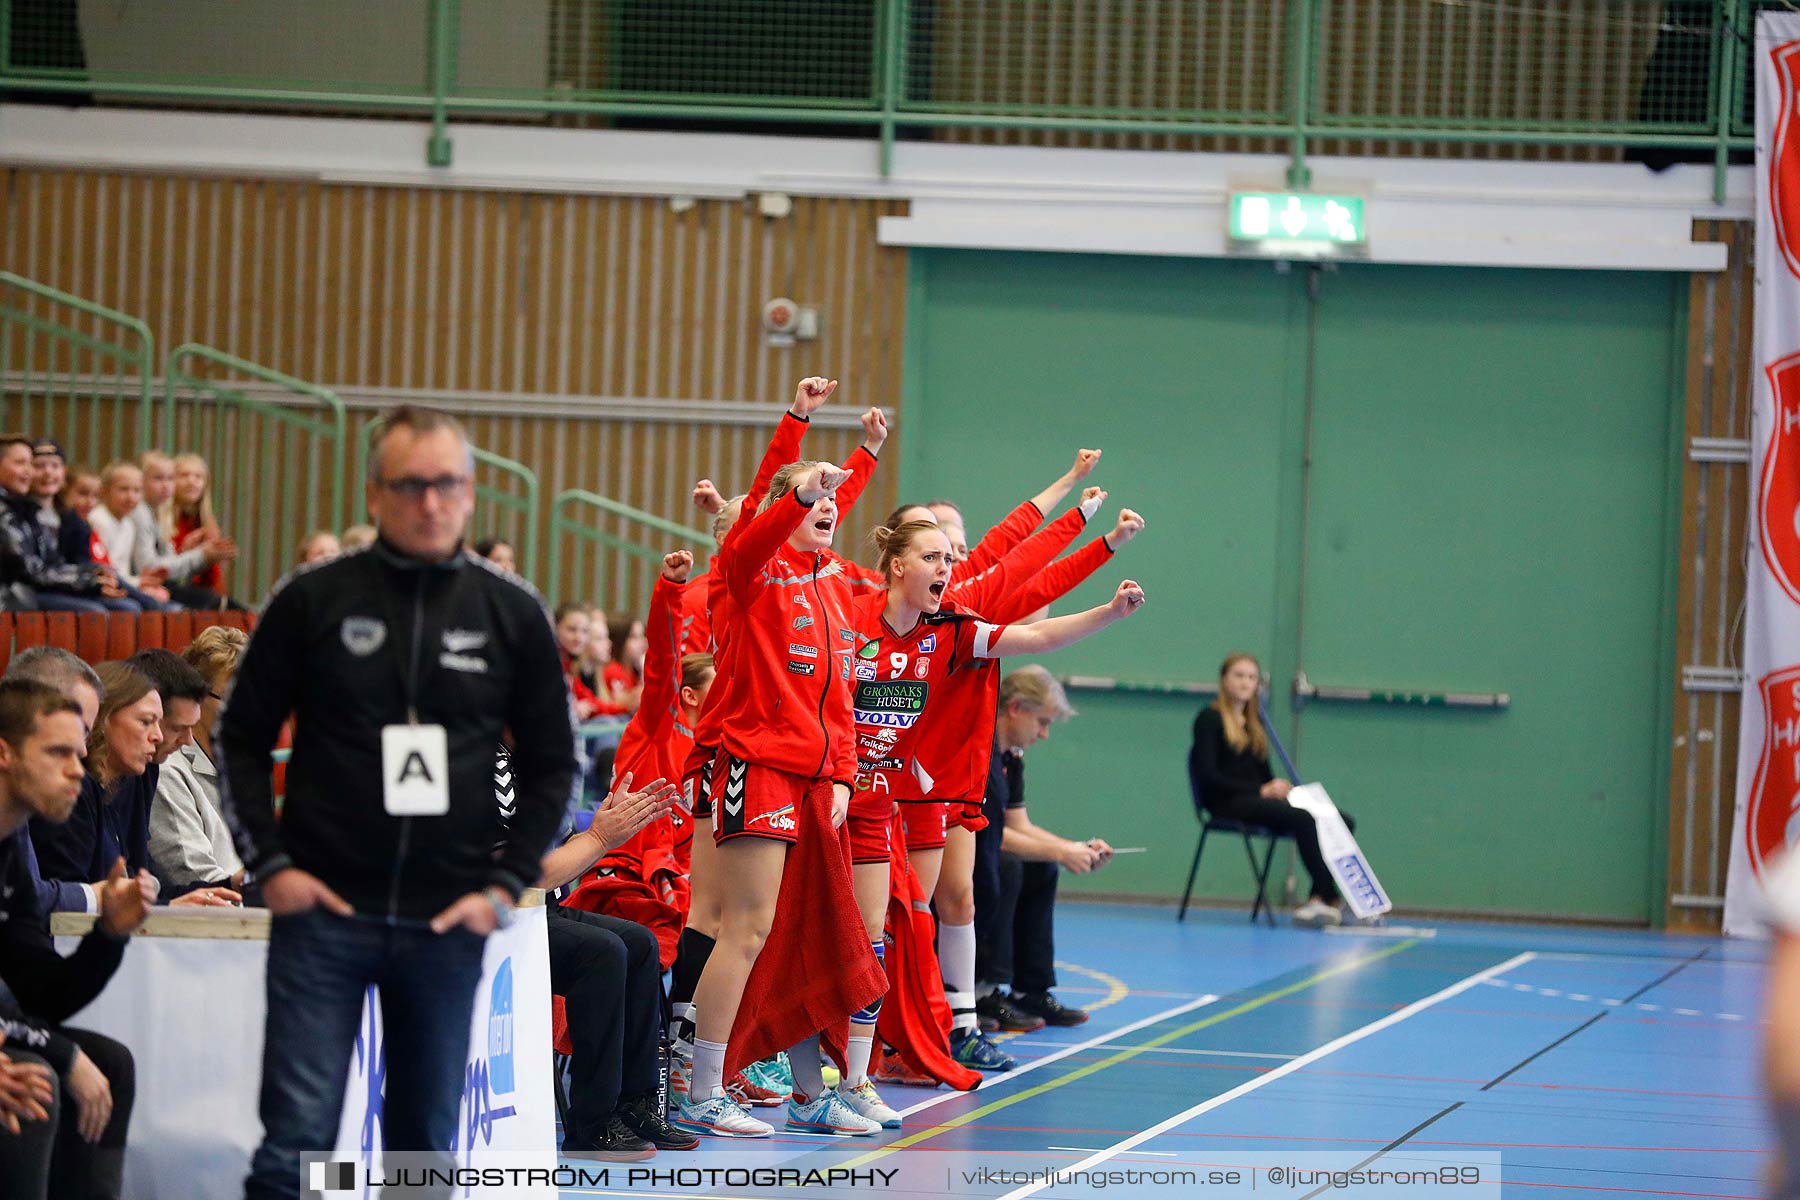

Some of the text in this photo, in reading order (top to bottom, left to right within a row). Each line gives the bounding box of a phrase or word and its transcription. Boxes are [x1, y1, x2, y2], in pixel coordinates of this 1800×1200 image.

[890, 652, 908, 679] 9
[863, 685, 922, 698] GRÖNSAKS
[876, 696, 914, 709] HUSET
[398, 752, 434, 783] A
